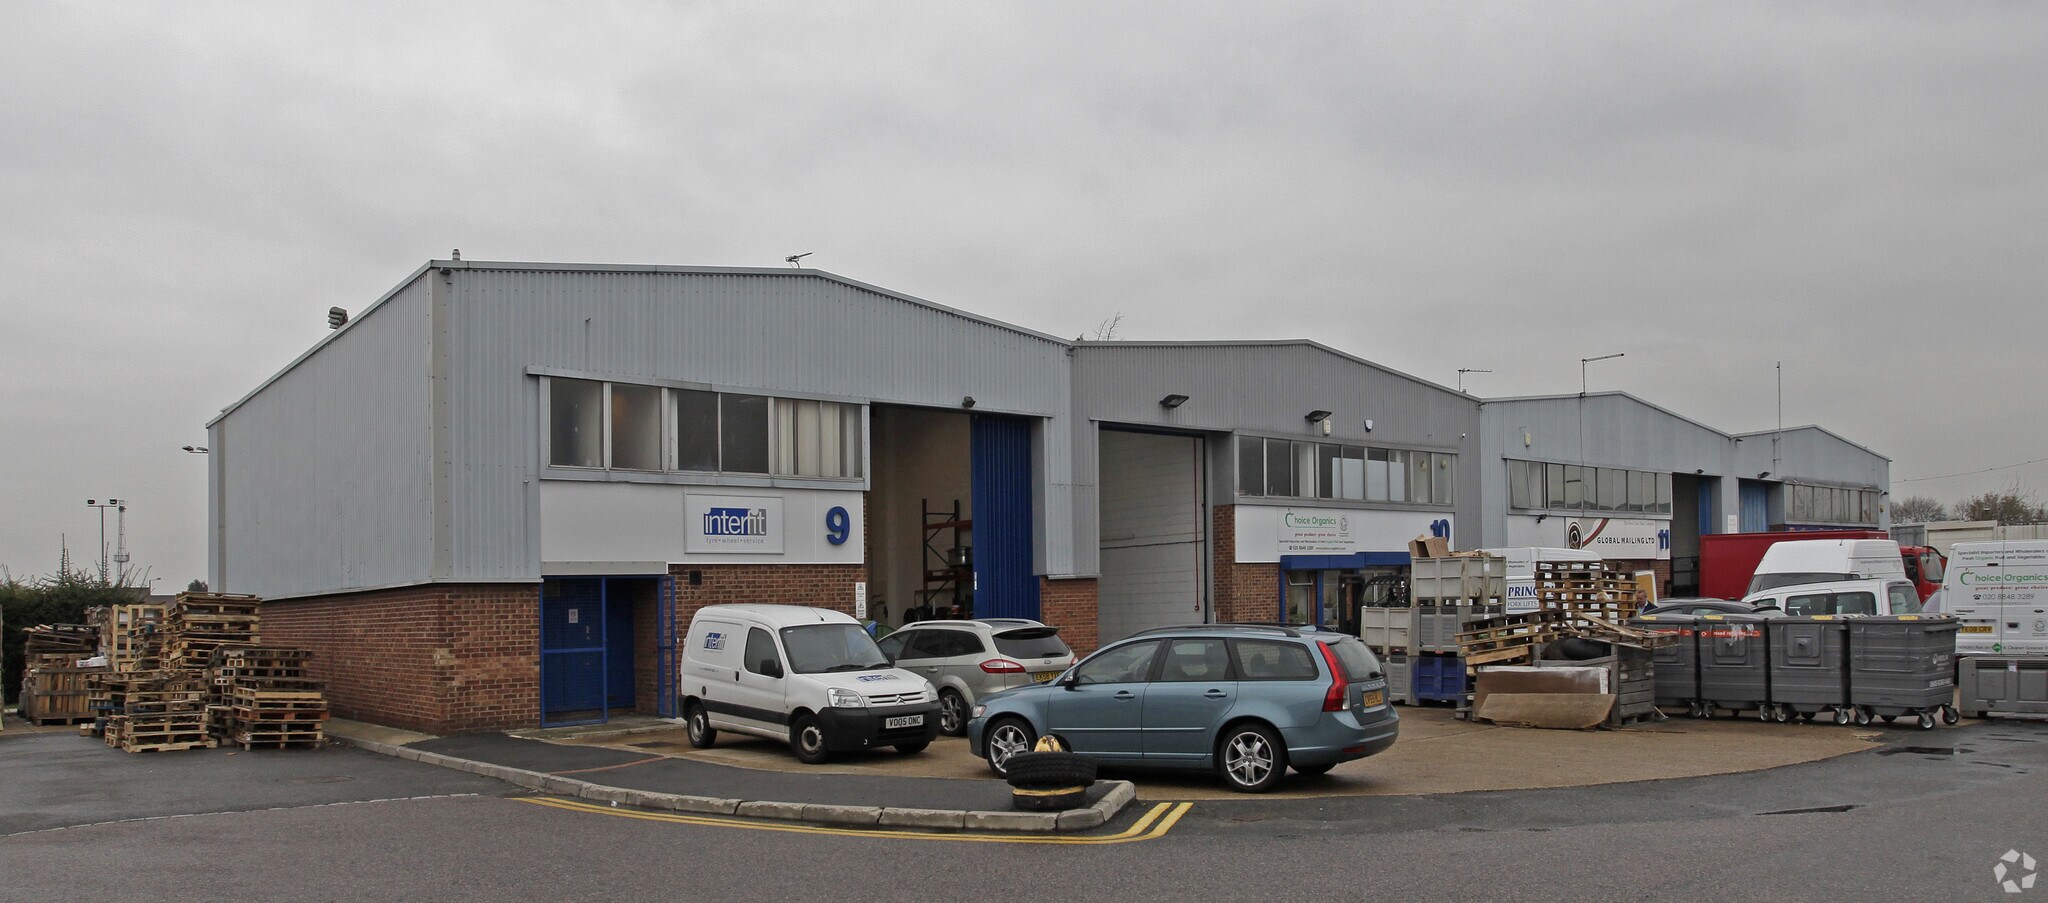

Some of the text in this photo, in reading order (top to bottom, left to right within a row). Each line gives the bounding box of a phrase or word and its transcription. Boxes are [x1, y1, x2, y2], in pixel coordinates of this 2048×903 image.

[704, 507, 766, 535] interfit
[825, 506, 850, 546] 9
[1285, 511, 1337, 528] Choice Organics
[1430, 518, 1451, 543] 10
[1597, 536, 1620, 544] GLOBAL
[1657, 529, 1669, 550] 11
[1960, 571, 2048, 586] Choice Organics
